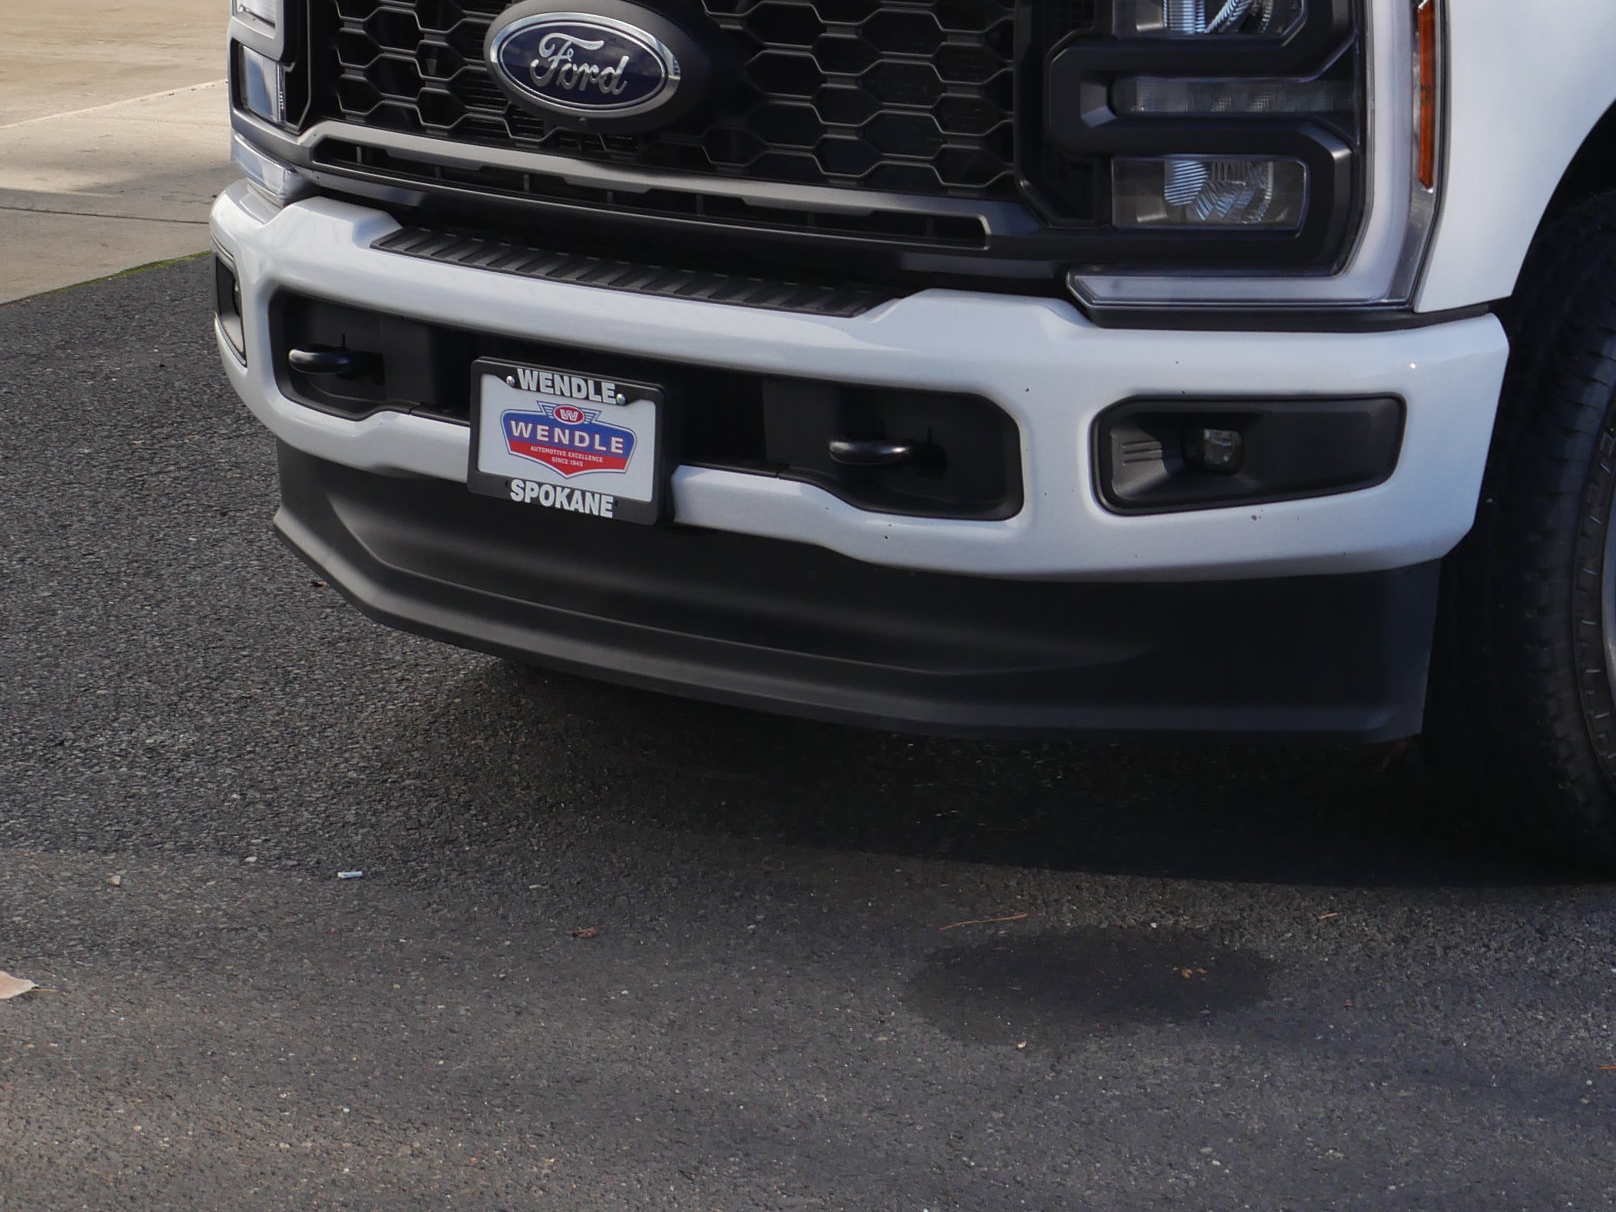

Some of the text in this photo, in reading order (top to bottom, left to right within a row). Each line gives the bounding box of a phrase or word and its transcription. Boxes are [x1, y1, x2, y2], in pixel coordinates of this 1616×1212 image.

[529, 32, 630, 95] Ford
[516, 368, 618, 405] WENDLE
[510, 420, 624, 454] WENDLE
[530, 445, 604, 463] AUTOMOTIVE EXCELLENCE
[551, 456, 569, 465] SINCE
[510, 478, 615, 519] SPOKANE
